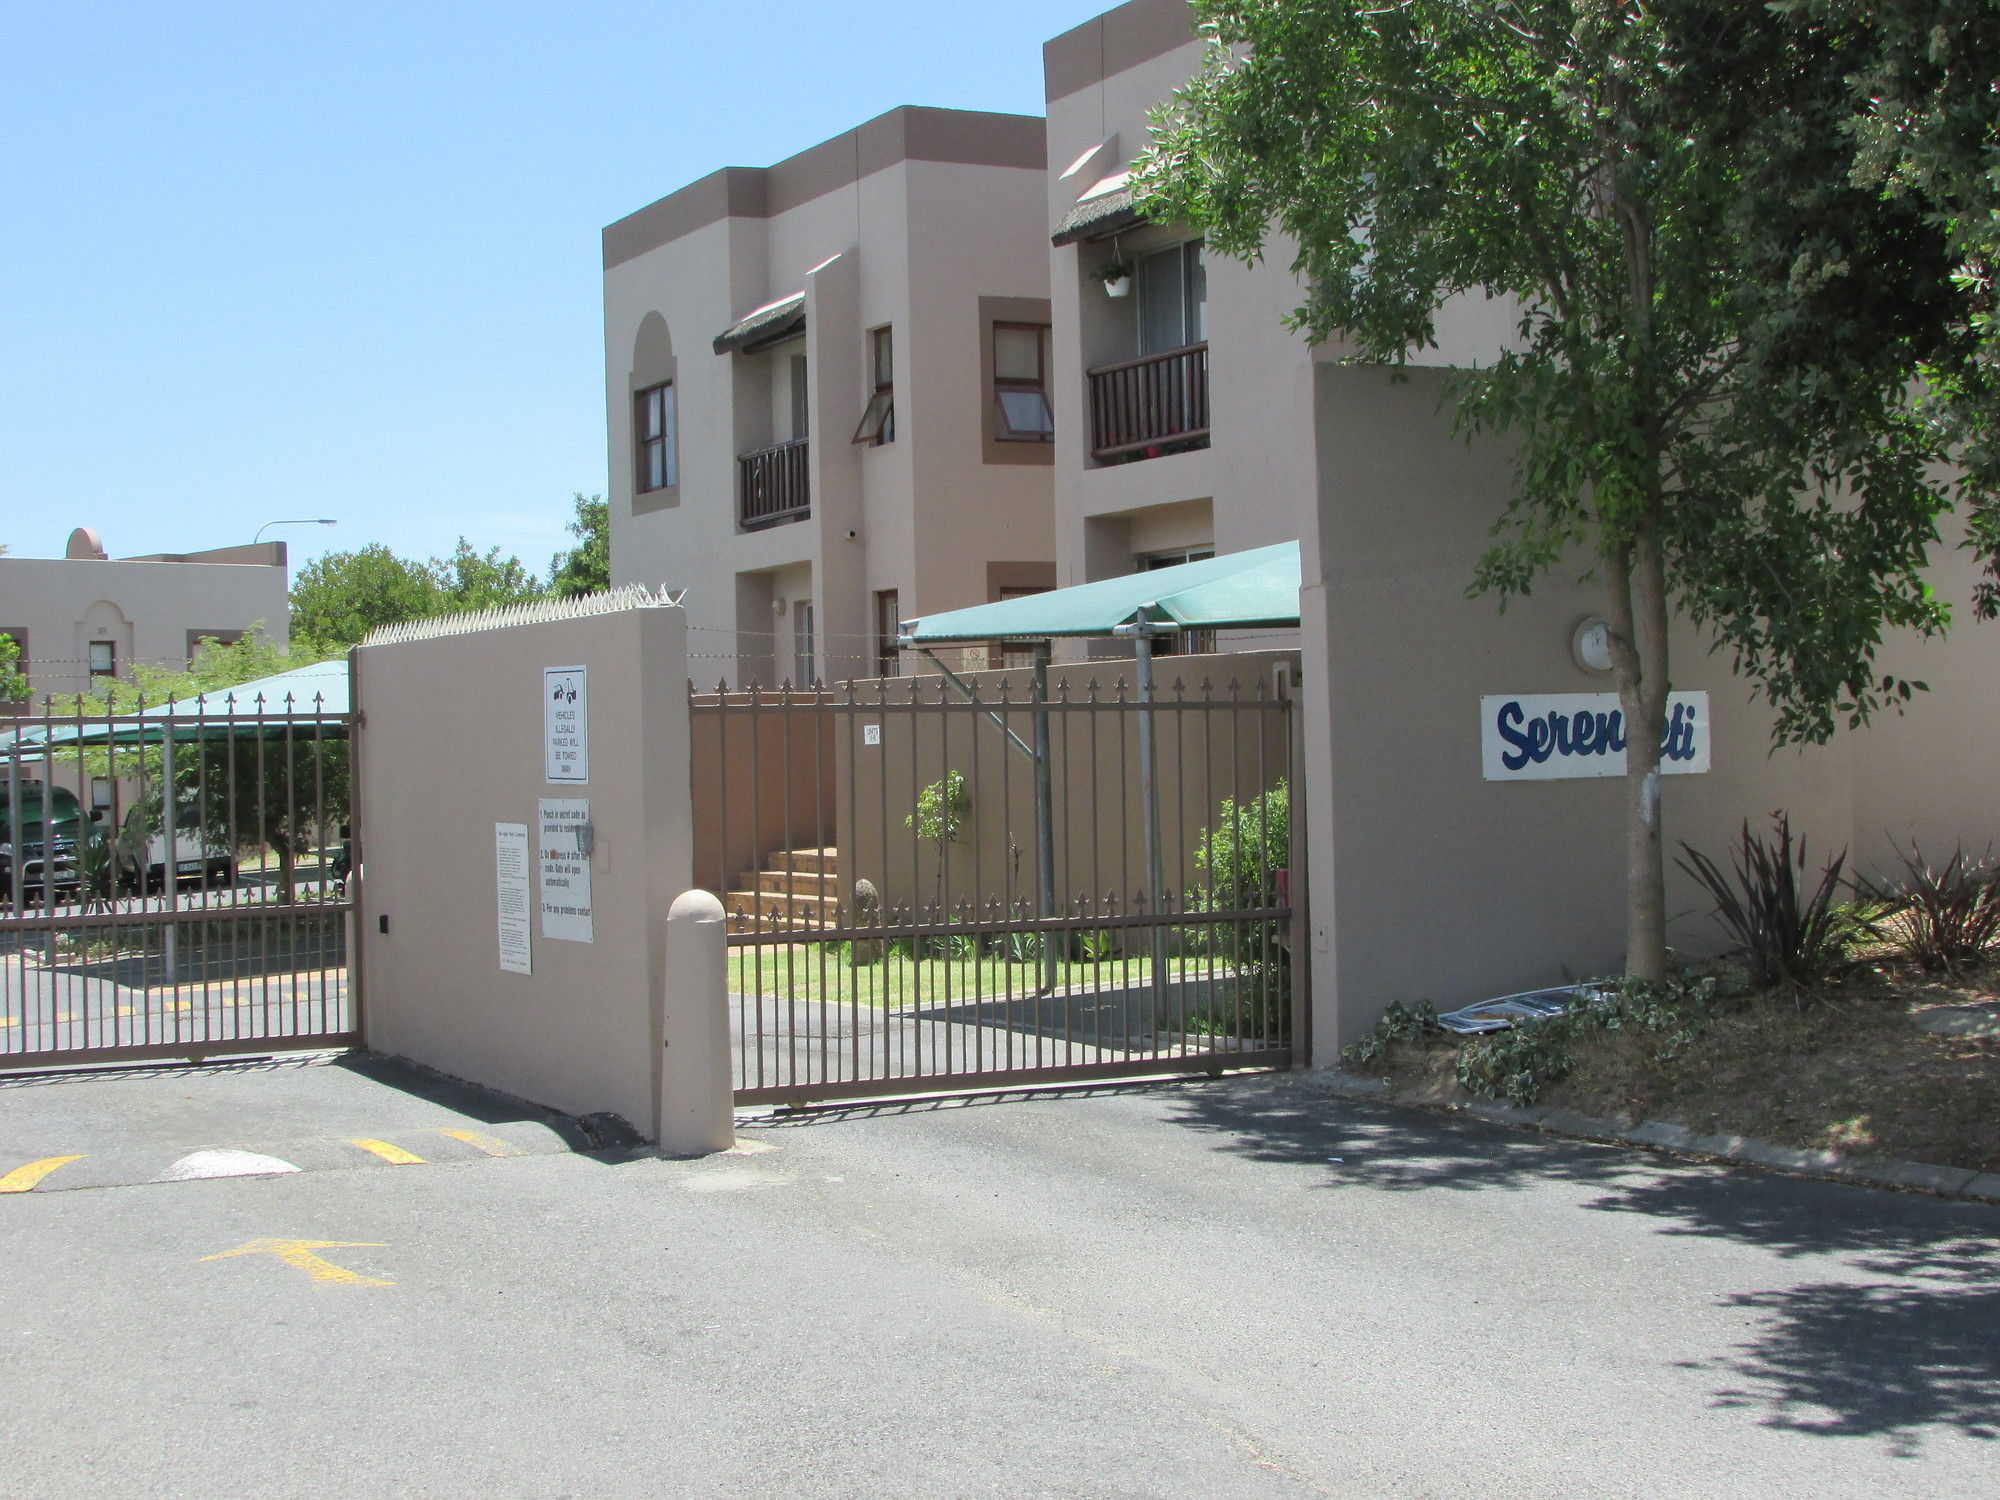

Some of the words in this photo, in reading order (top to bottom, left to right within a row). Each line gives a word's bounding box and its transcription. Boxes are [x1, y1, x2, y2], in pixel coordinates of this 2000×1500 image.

[555, 711, 575, 720] VEHICLES
[555, 725, 576, 734] ILLEGALLY
[1498, 702, 1696, 770] Serenti
[553, 738, 568, 747] PARKED
[569, 738, 579, 747] WILL
[555, 751, 562, 760] BE
[562, 751, 577, 761] TOWED
[559, 810, 571, 819] secret
[571, 810, 580, 819] code
